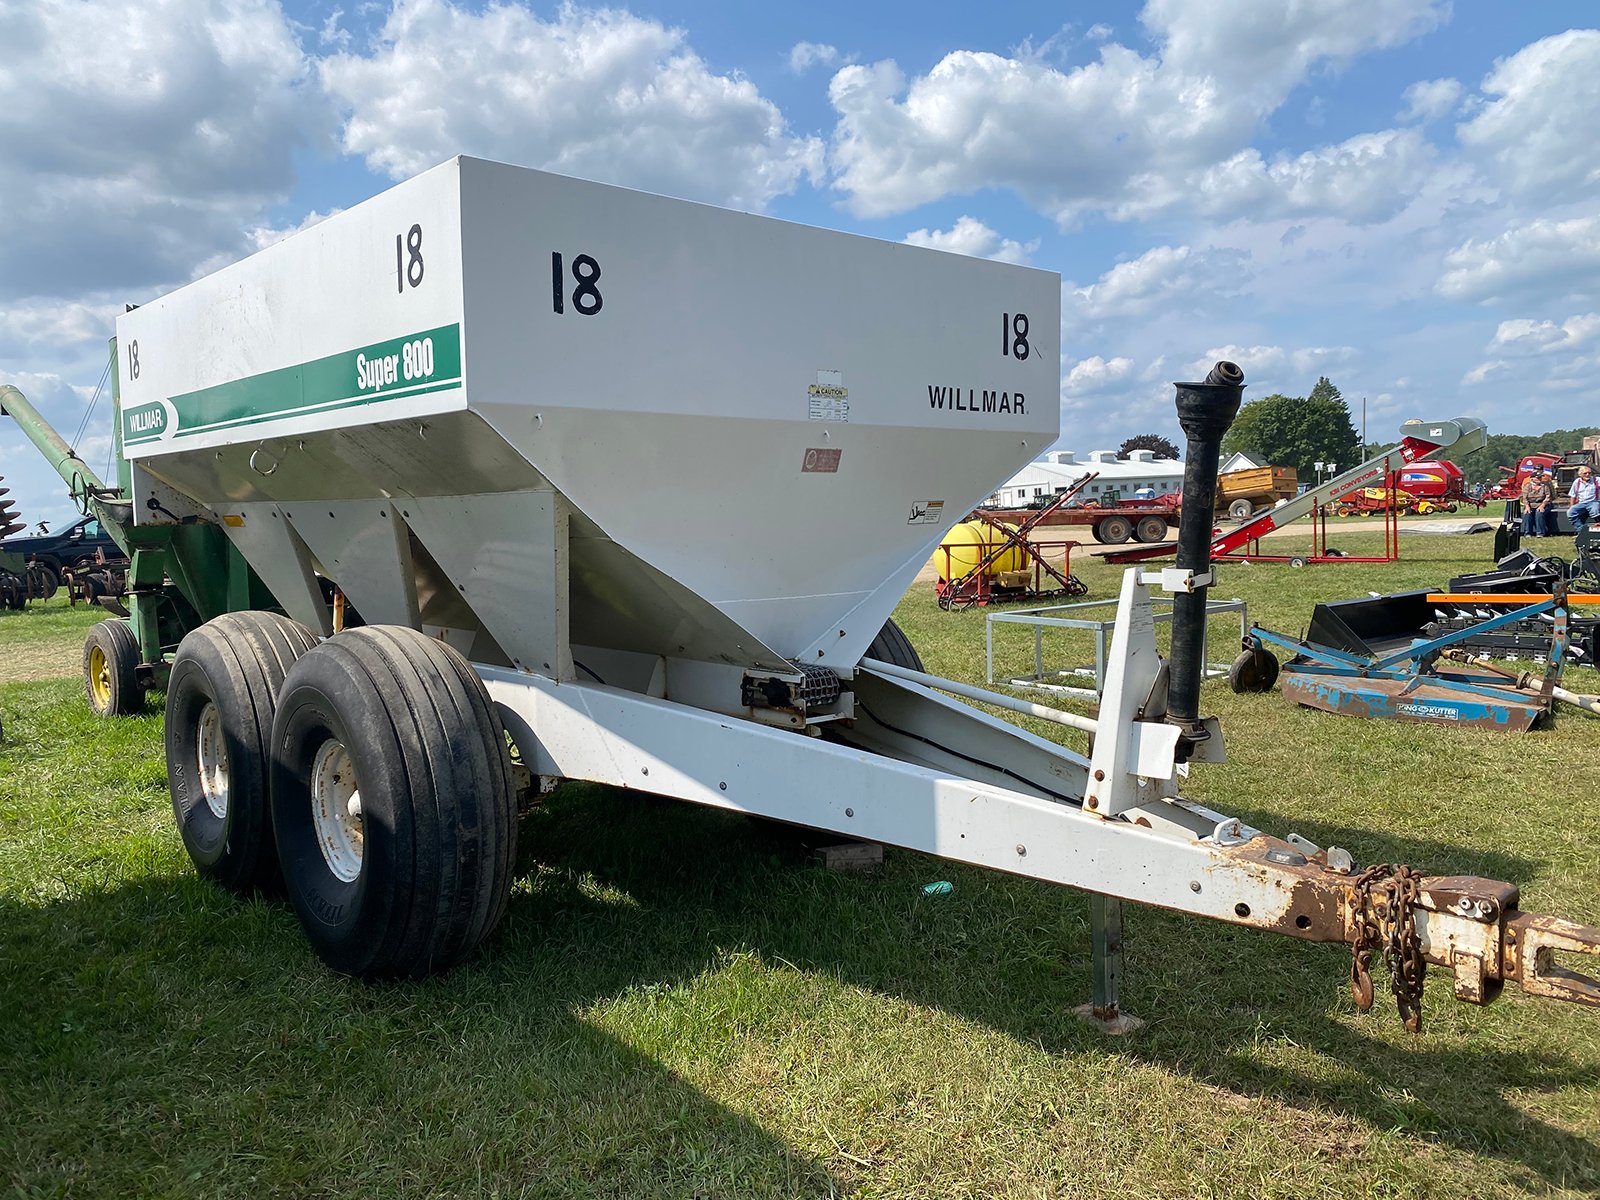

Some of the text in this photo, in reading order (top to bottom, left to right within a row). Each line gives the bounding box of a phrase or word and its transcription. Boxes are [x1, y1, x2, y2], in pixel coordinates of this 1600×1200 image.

[396, 223, 424, 294] 18
[551, 251, 603, 316] 18
[128, 339, 140, 381] 18
[1002, 312, 1030, 361] 18
[356, 337, 435, 391] Super 800
[129, 408, 162, 433] WILLMAR
[927, 384, 1026, 415] WILLMAR
